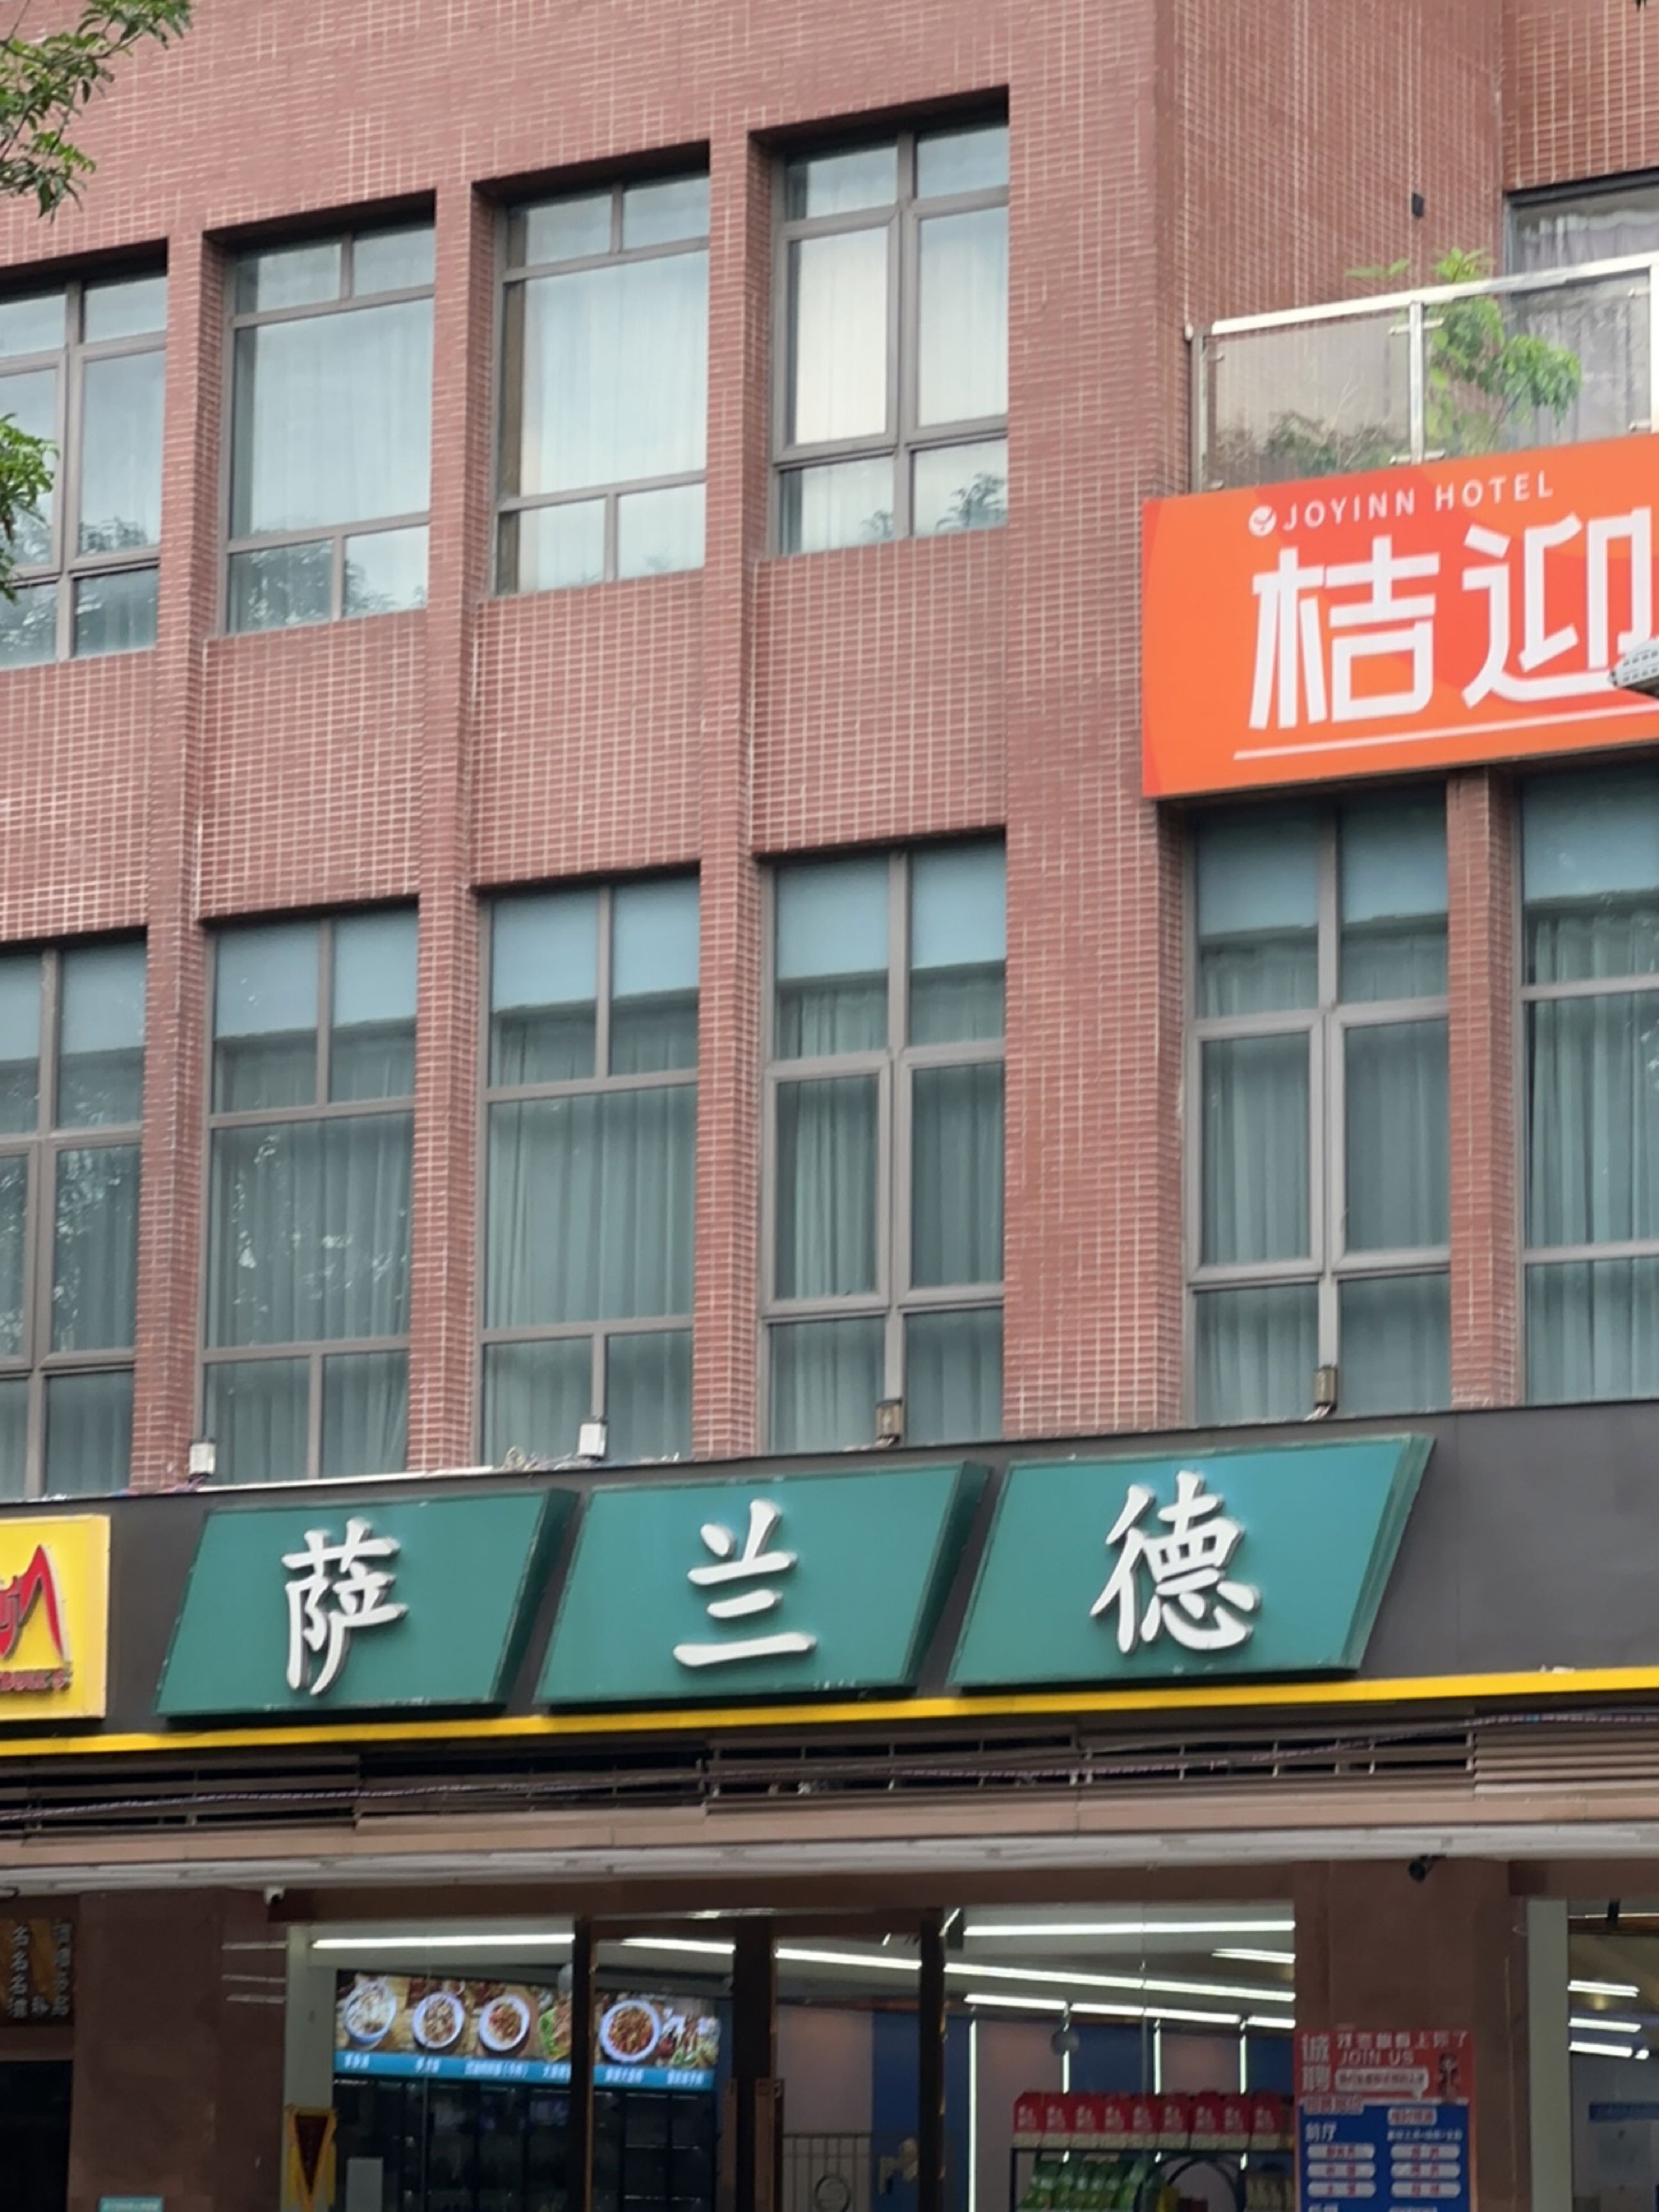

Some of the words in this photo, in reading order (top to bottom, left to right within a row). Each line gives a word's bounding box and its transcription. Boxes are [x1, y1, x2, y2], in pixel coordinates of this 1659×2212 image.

[1283, 488, 1415, 531] JOYINN
[1436, 470, 1553, 512] HOTEL
[1249, 506, 1658, 730] 桔迎
[282, 1470, 1260, 1696] 萨兰德
[1388, 2049, 1414, 2065] US
